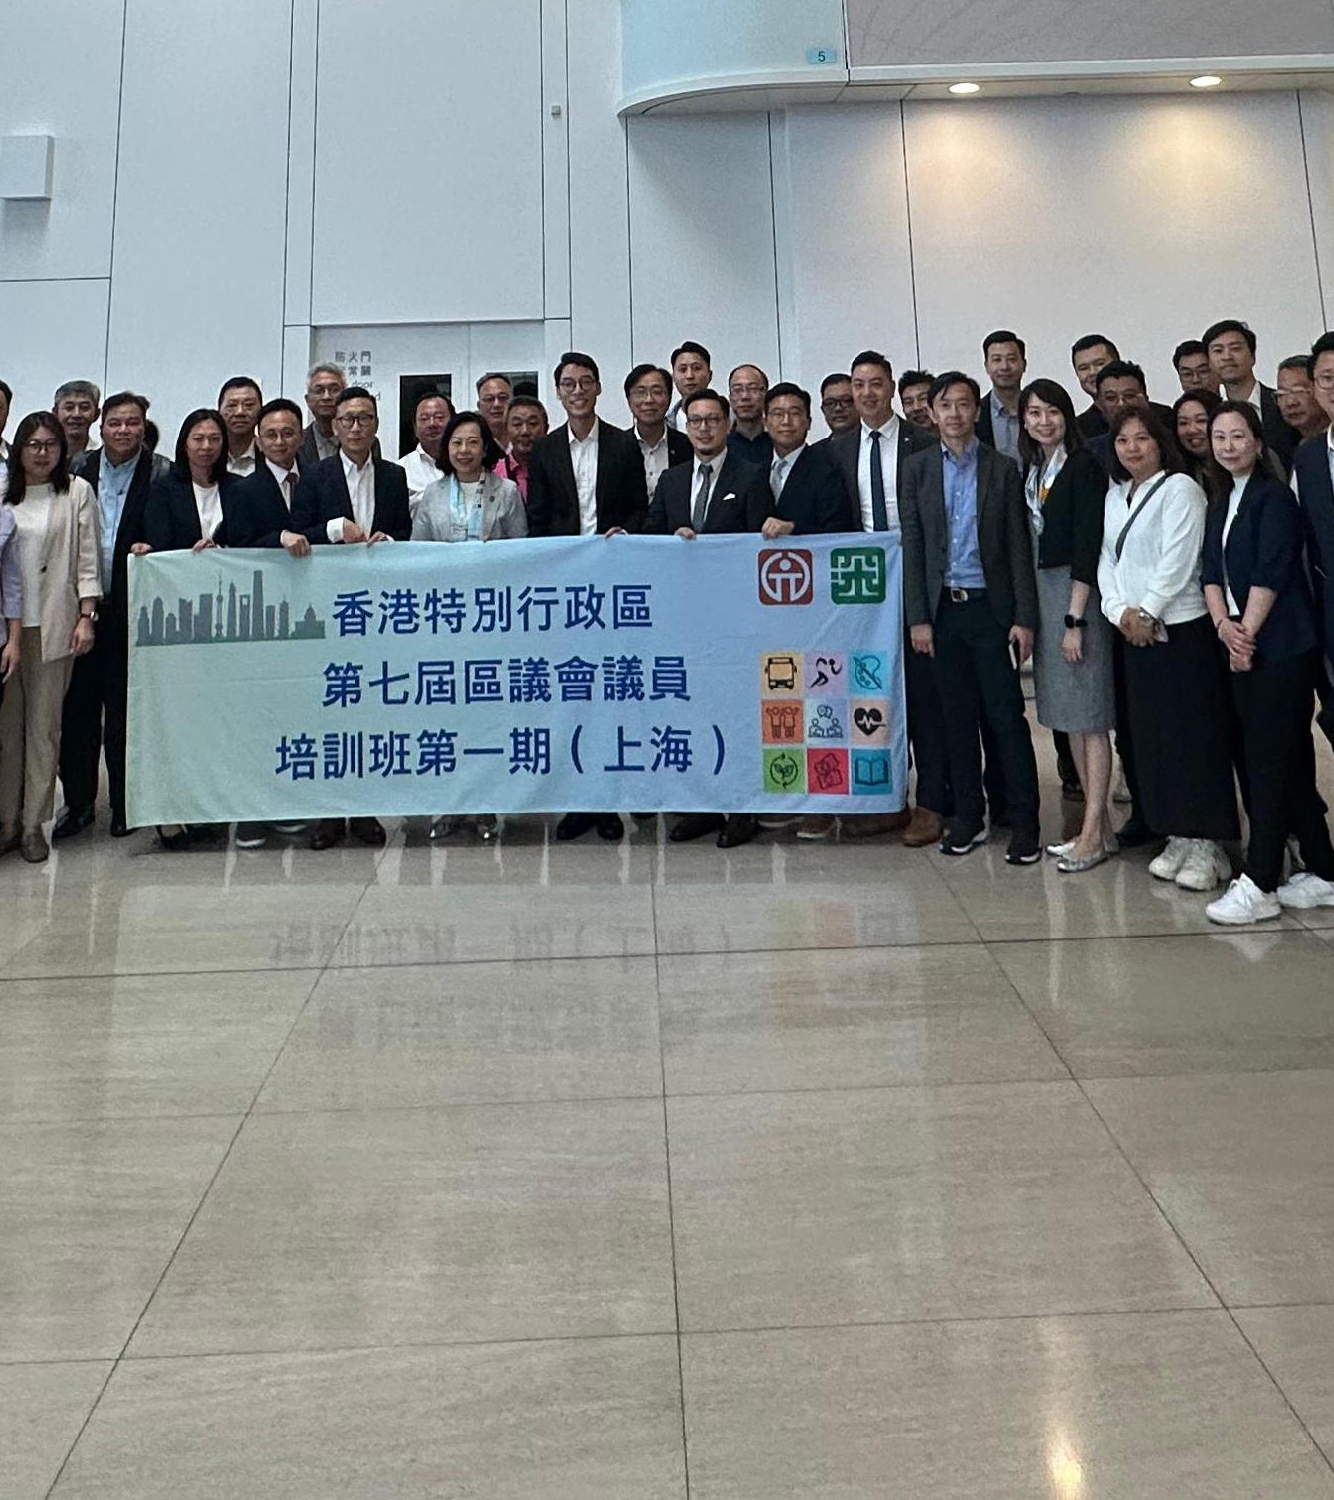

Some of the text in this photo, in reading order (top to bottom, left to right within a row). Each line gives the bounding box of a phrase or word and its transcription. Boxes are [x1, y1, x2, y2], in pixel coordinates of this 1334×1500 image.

[817, 50, 826, 62] 5
[335, 350, 371, 363] 防火門
[339, 365, 371, 376] 常關
[332, 583, 653, 636] 香港特別行政區
[322, 654, 692, 707] 第七屆區議會議員
